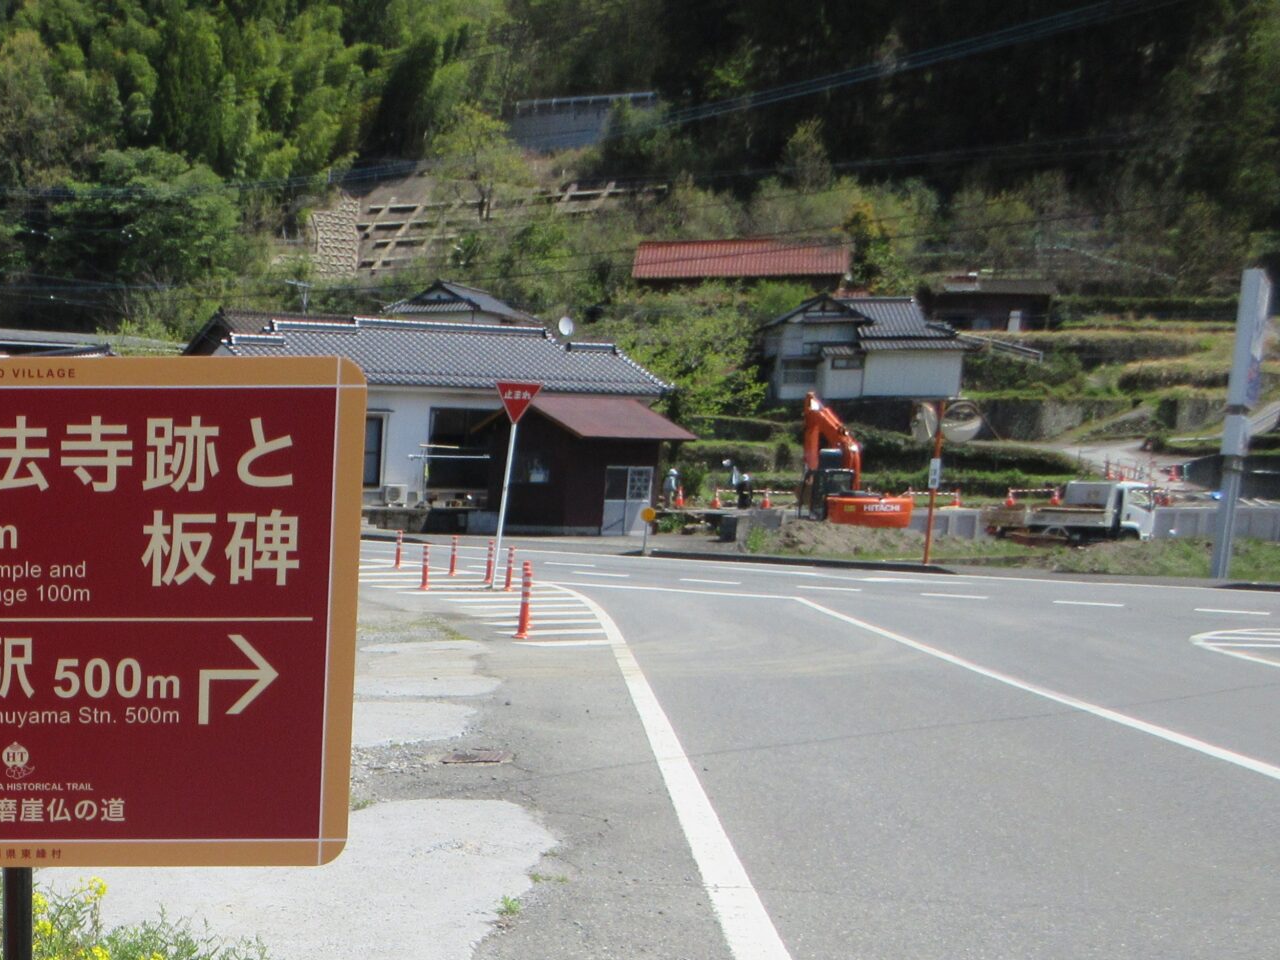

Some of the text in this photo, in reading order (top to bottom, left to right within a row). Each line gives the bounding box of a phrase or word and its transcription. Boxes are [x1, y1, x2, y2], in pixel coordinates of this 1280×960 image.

[12, 368, 76, 379] VILLAGE
[503, 389, 531, 400] 止まれ
[863, 503, 901, 512] HITACHI
[141, 509, 300, 587] 板碑
[49, 560, 87, 578] and
[36, 584, 91, 602] 100m
[53, 658, 180, 699] 500m
[78, 706, 117, 724] Stn.
[125, 706, 180, 724] 500m
[5, 751, 27, 763] HT
[6, 782, 63, 792] HISTORICAL
[66, 782, 94, 792] TRAIL
